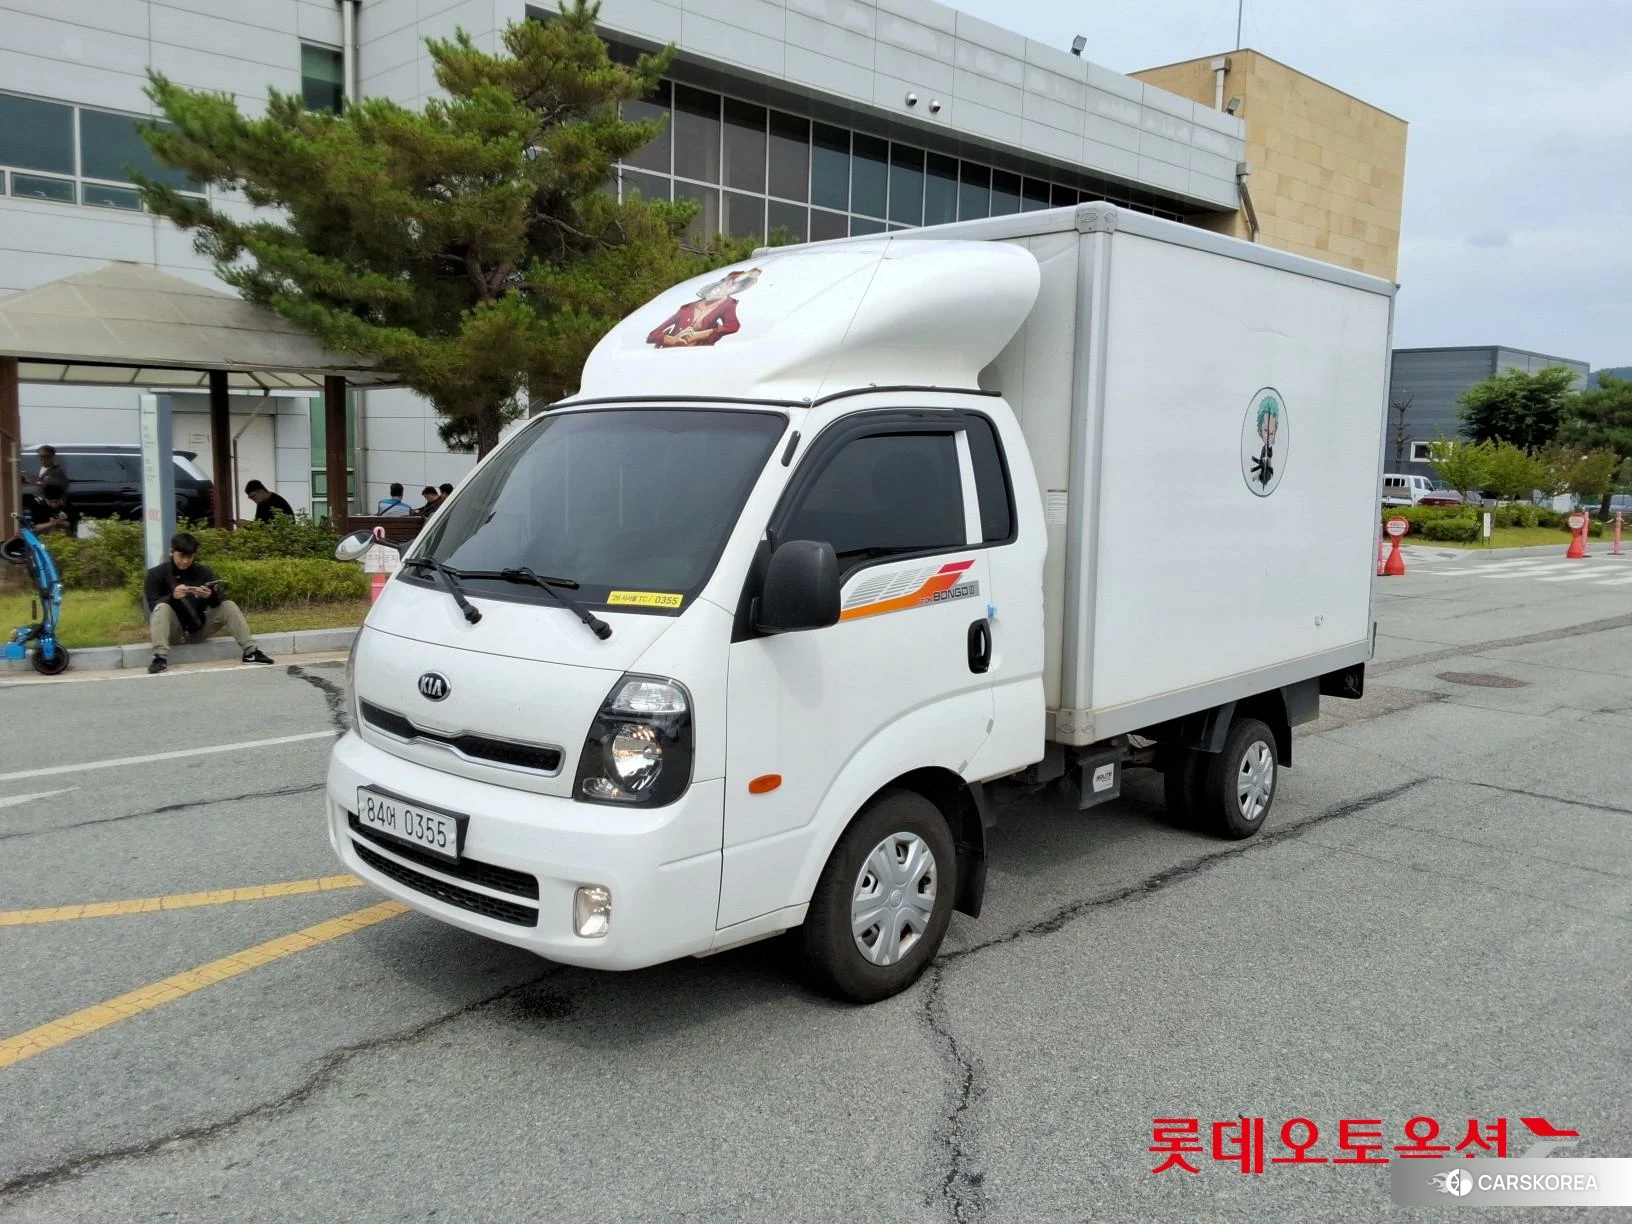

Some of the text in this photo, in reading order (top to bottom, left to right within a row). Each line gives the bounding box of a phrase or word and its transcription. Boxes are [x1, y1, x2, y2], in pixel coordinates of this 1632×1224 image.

[655, 595, 679, 605] 0355
[934, 586, 969, 601] BONGO
[420, 675, 443, 697] KIA
[367, 797, 447, 848] 84어 0355
